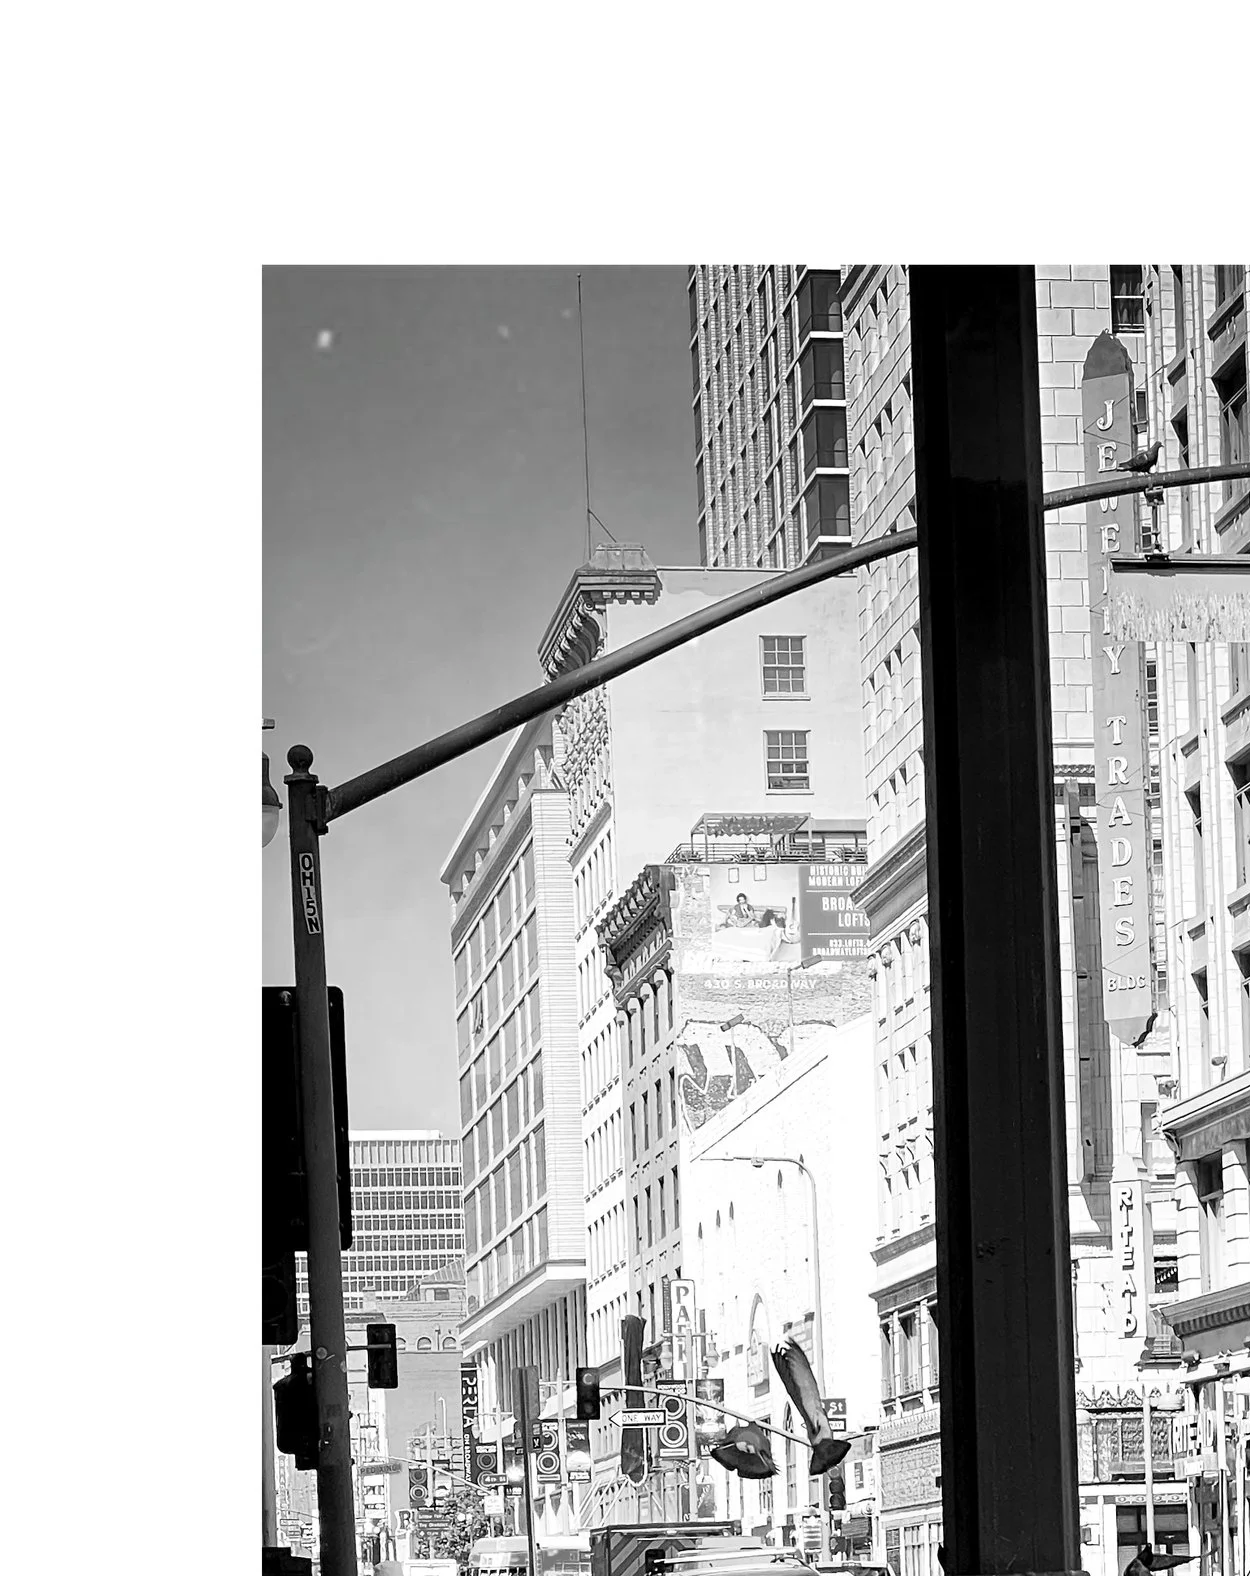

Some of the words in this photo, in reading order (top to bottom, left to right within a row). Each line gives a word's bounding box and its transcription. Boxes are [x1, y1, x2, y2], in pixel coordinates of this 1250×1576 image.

[1105, 714, 1136, 947] TRADES
[822, 896, 859, 911] BROA
[1117, 1186, 1135, 1271] RITE
[1121, 1273, 1138, 1339] AID
[461, 1377, 478, 1429] PERLA
[621, 1414, 638, 1423] ONE
[644, 1413, 662, 1422] WAY
[829, 1402, 843, 1412] St
